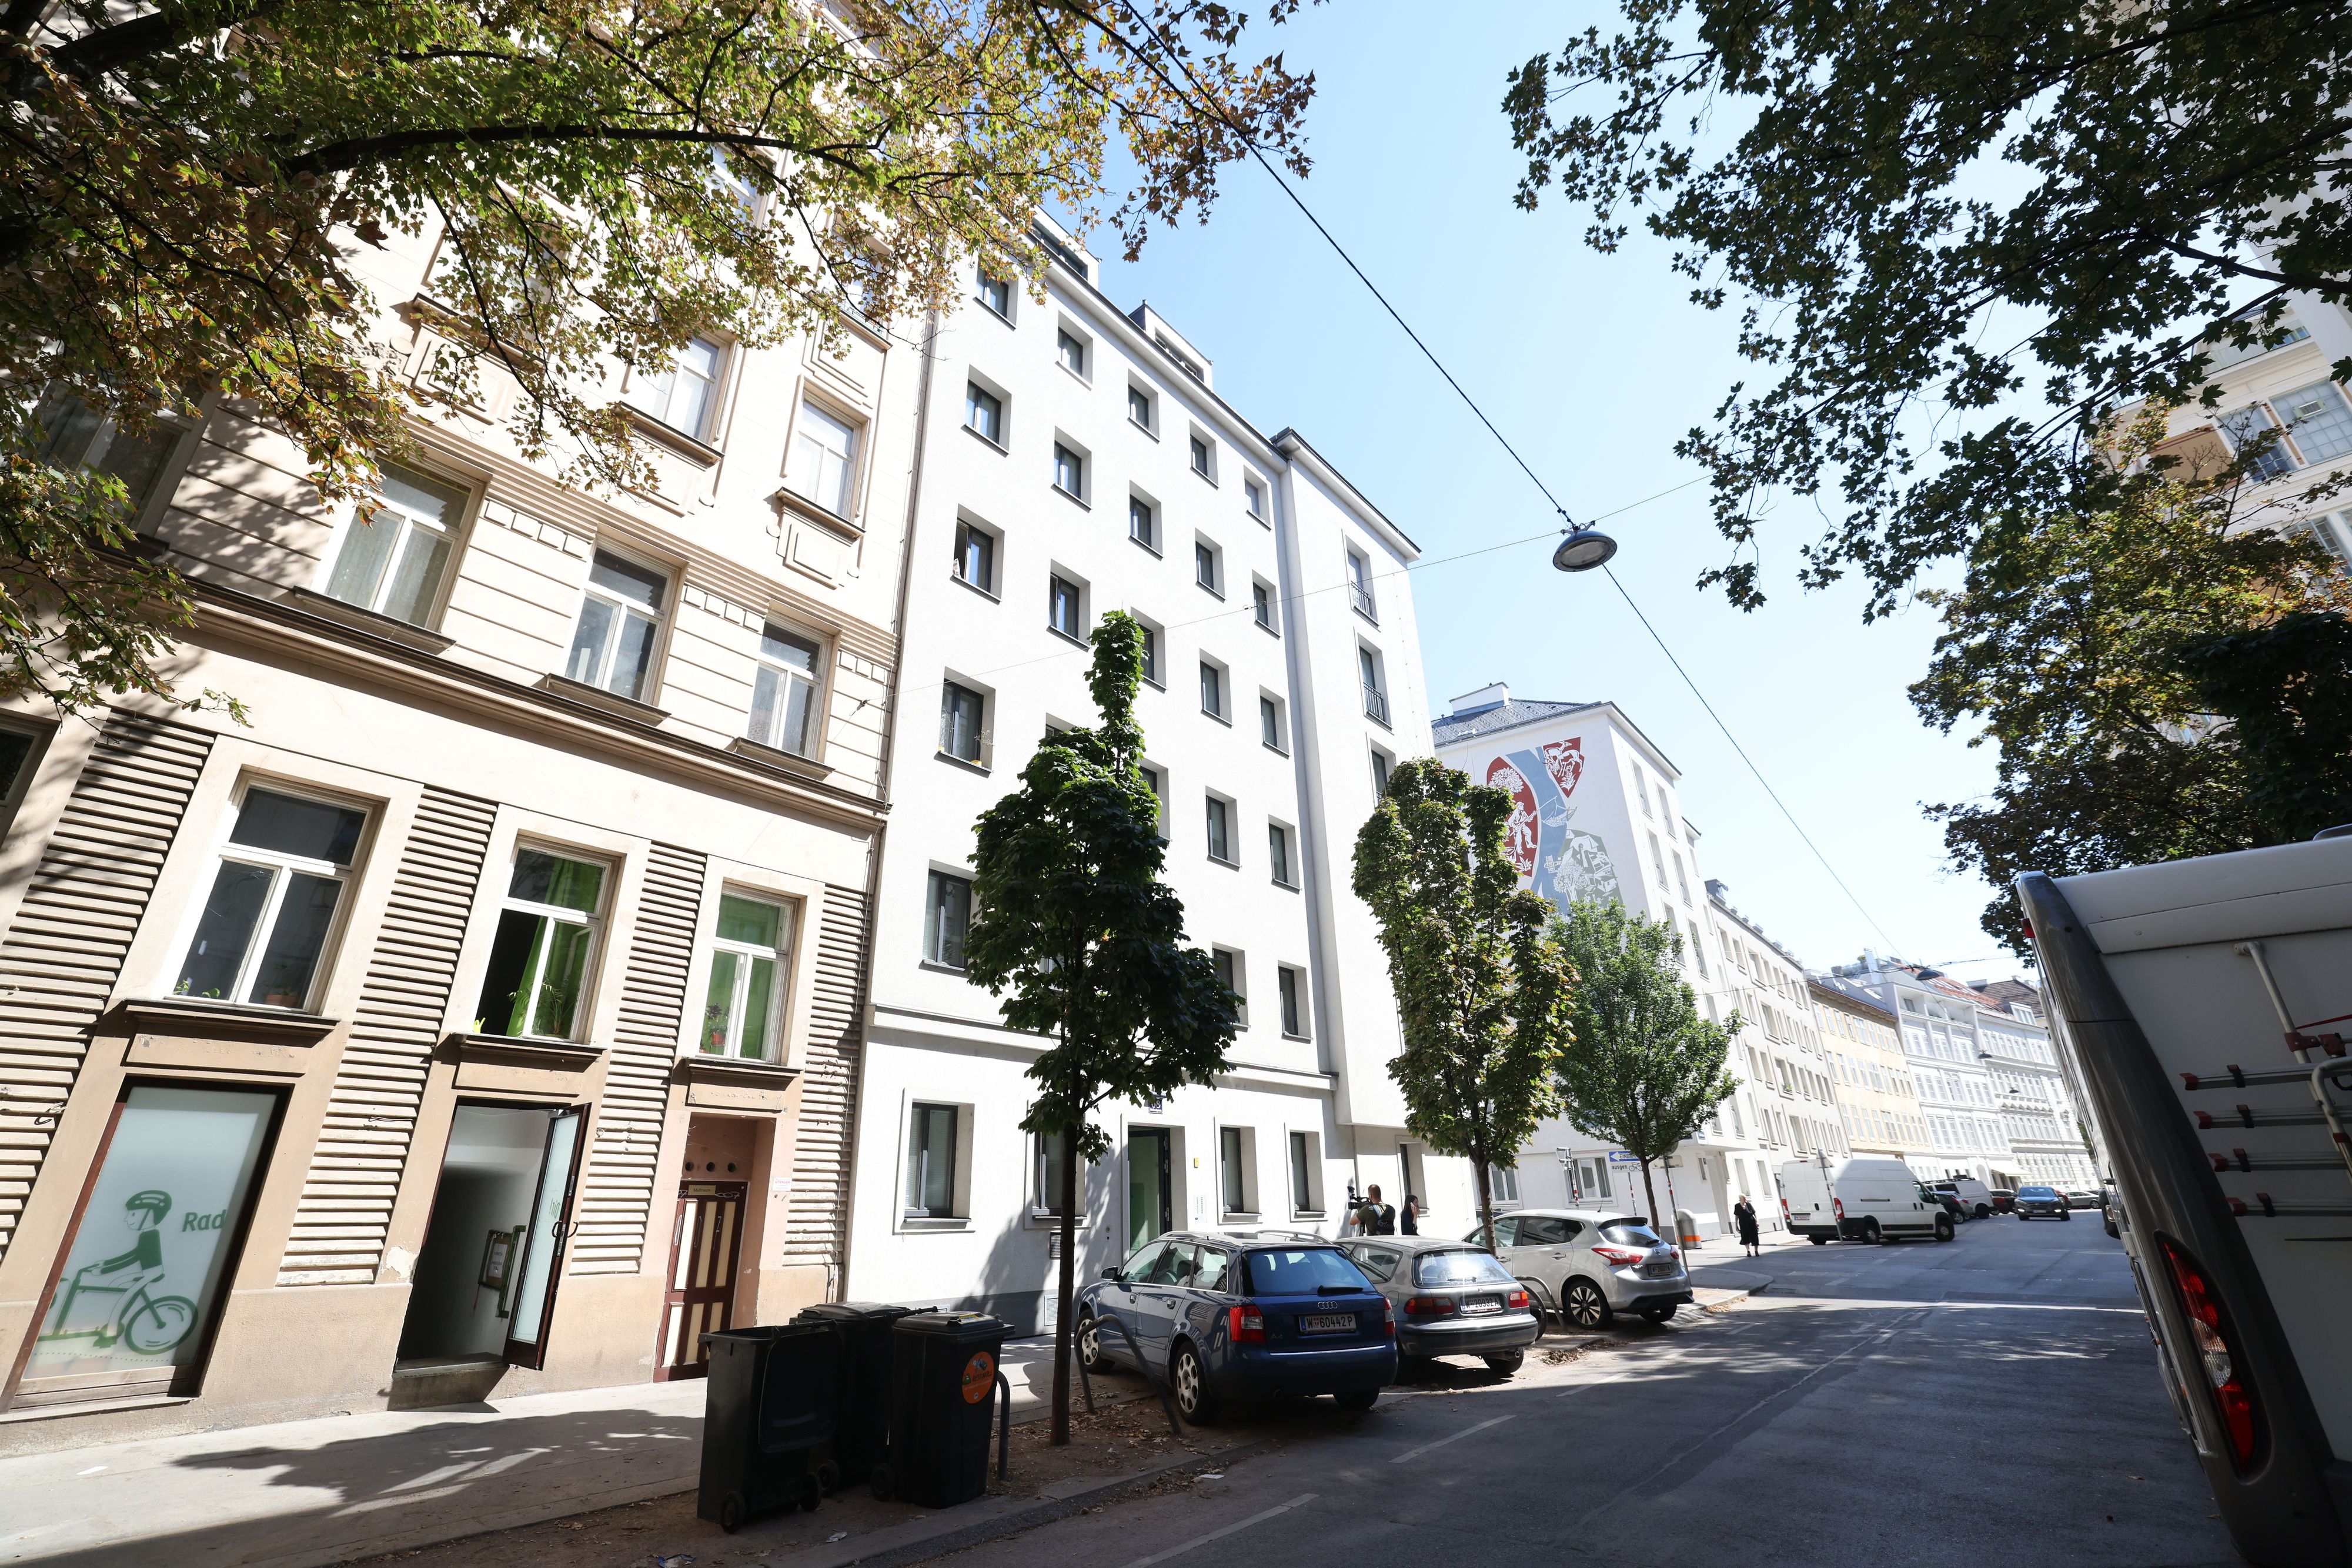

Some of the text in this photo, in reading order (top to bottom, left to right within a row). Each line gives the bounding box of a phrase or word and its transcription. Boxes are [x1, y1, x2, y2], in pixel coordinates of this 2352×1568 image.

[182, 1209, 227, 1233] Rad
[1307, 1316, 1352, 1328] W 60442 P
